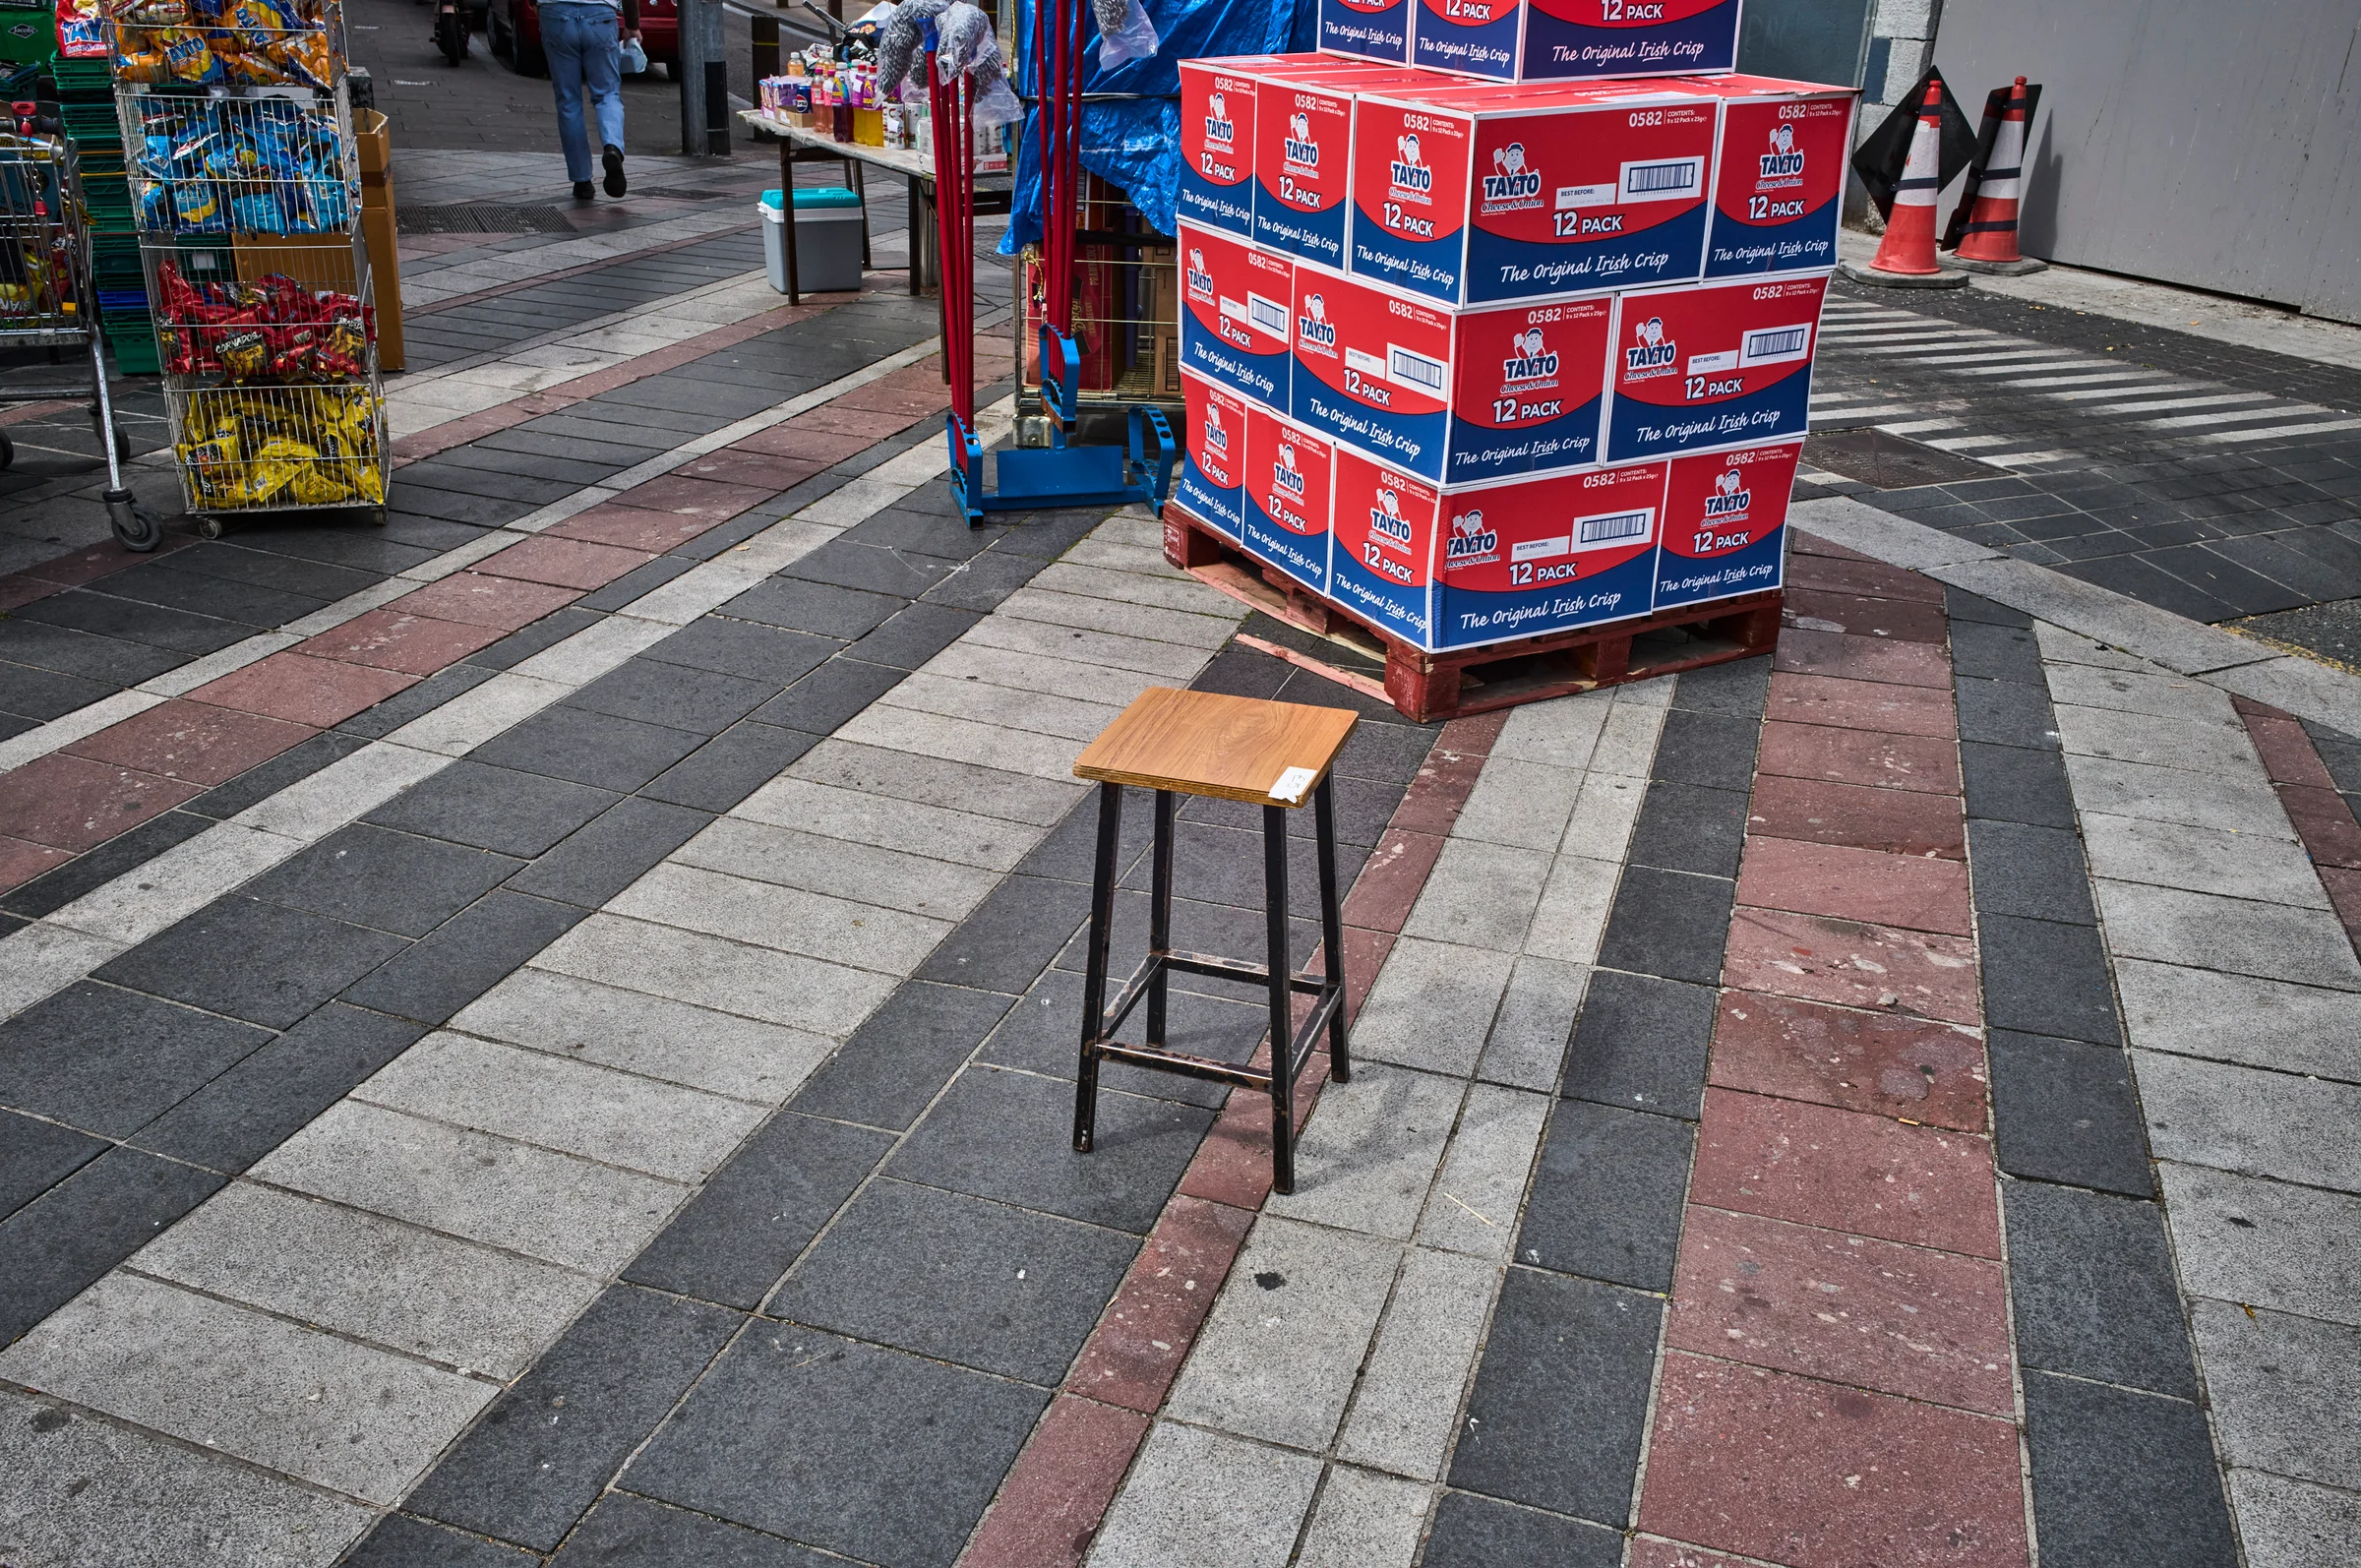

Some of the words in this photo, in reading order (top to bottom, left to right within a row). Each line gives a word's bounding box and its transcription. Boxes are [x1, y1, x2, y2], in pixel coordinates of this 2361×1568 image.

[1446, 0, 1460, 16] 12
[1463, 4, 1490, 20] PACK
[1601, 0, 1622, 21] 12
[1626, 4, 1663, 20] PACK
[1326, 22, 1338, 34] The
[1339, 26, 1366, 42] Original
[1368, 27, 1384, 44] Irish
[1386, 33, 1402, 50] Crisp
[165, 36, 207, 64] AYTO
[1420, 37, 1435, 51] The
[1436, 42, 1467, 59] Original
[1469, 43, 1489, 61] Irish
[1490, 49, 1510, 67] Crisp
[1552, 46, 1579, 62] The
[1582, 42, 1636, 66] Original
[1638, 41, 1671, 62] Irish
[1673, 41, 1704, 61] Crisp
[1215, 77, 1233, 91] 0582
[1295, 94, 1316, 110] 0582
[1778, 105, 1806, 119] 0582
[1207, 119, 1232, 141] TAYTO
[1404, 113, 1429, 131] 0582
[1629, 111, 1662, 127] 0582
[1287, 140, 1317, 165] TAYTO
[1761, 154, 1802, 175] TAYTO
[1201, 152, 1213, 174] 12
[1214, 163, 1235, 181] PACK
[1393, 164, 1430, 190] TAYTO
[1279, 175, 1293, 200] 12
[1296, 190, 1321, 208] PACK
[1485, 174, 1539, 197] TAYTO
[1183, 189, 1194, 203] The
[1195, 194, 1219, 212] Original
[1219, 199, 1235, 217] Irish
[1235, 206, 1250, 225] Crisp
[1749, 195, 1769, 219] 12
[1771, 199, 1805, 217] PACK
[1383, 202, 1401, 229] 12
[1404, 215, 1434, 238] PACK
[1553, 210, 1577, 237] 12
[1581, 214, 1624, 234] PACK
[1258, 216, 1272, 230] The
[1273, 222, 1301, 240] Original
[1302, 228, 1320, 248] Irish
[1321, 237, 1338, 257] Crisp
[1248, 252, 1266, 269] 0582
[1714, 248, 1734, 261] The
[1735, 244, 1777, 264] Original
[1778, 240, 1803, 258] Irish
[1805, 239, 1828, 256] Crisp
[1357, 245, 1374, 261] The
[1375, 253, 1409, 272] Original
[1410, 260, 1432, 280] Irish
[1433, 269, 1454, 290] Crisp
[1500, 265, 1530, 283] The
[1533, 257, 1592, 284] Original
[1594, 253, 1632, 277] Irish
[1635, 252, 1669, 273] Crisp
[1189, 270, 1212, 293] TAYTO
[1753, 286, 1783, 301] 0582
[1389, 300, 1413, 319] 0582
[1528, 308, 1561, 324] 0582
[1219, 315, 1230, 339] 12
[1231, 328, 1251, 348] PACK
[1301, 319, 1334, 343] TAYTO
[1506, 355, 1557, 379] TAYTO
[1628, 344, 1675, 367] TAYTO
[1194, 342, 1207, 360] The
[1207, 350, 1236, 373] Original
[1236, 360, 1255, 385] Irish
[1256, 374, 1274, 398] Crisp
[1209, 389, 1225, 406] 0582
[1344, 369, 1360, 395] 12
[1362, 383, 1391, 407] PACK
[1685, 377, 1705, 401] 12
[1708, 378, 1744, 396] PACK
[1493, 399, 1517, 423] 12
[1521, 400, 1563, 419] PACK
[1206, 423, 1226, 448] TAYTO
[1282, 427, 1301, 446] 0582
[1310, 399, 1328, 417] The
[1330, 409, 1368, 433] Original
[1368, 422, 1394, 448] Irish
[1395, 437, 1421, 462] Crisp
[1637, 427, 1662, 442] The
[1665, 417, 1716, 443] Original
[1718, 412, 1749, 434] Irish
[1751, 410, 1781, 429] Crisp
[1456, 452, 1479, 465] The
[1481, 444, 1528, 465] Original
[1531, 439, 1560, 458] Irish
[1562, 437, 1590, 453] Crisp
[1726, 452, 1755, 466] 0582
[1202, 451, 1211, 473] 12
[1212, 465, 1229, 486] PACK
[1275, 465, 1303, 492] TAYTO
[1381, 471, 1406, 491] 0582
[1583, 473, 1616, 488] 0582
[1182, 479, 1192, 493] The
[1193, 487, 1213, 506] Original
[1213, 497, 1227, 517] Irish
[1227, 508, 1240, 527] Crisp
[1268, 494, 1281, 519] 12
[1283, 509, 1307, 533] PACK
[1707, 492, 1749, 514] TAYTO
[1372, 510, 1410, 540] TAYTO
[1248, 524, 1261, 540] The
[1261, 534, 1288, 552] Original
[1288, 546, 1305, 566] Irish
[1305, 559, 1322, 579] Crisp
[1694, 531, 1712, 554] 12
[1715, 531, 1750, 549] PACK
[1363, 541, 1380, 568] 12
[1383, 558, 1413, 584] PACK
[1509, 563, 1533, 585] 12
[1537, 562, 1578, 581] PACK
[1660, 581, 1679, 592] The
[1682, 572, 1721, 591] Original
[1723, 567, 1747, 584] Irish
[1749, 564, 1773, 578] Crisp
[1336, 573, 1352, 590] The
[1353, 584, 1384, 607] Original
[1385, 598, 1406, 619] Irish
[1406, 612, 1426, 634] Crisp
[1461, 614, 1489, 629] The
[1492, 601, 1549, 628] Original
[1551, 596, 1586, 618] Irish
[1589, 592, 1621, 611] Crisp
